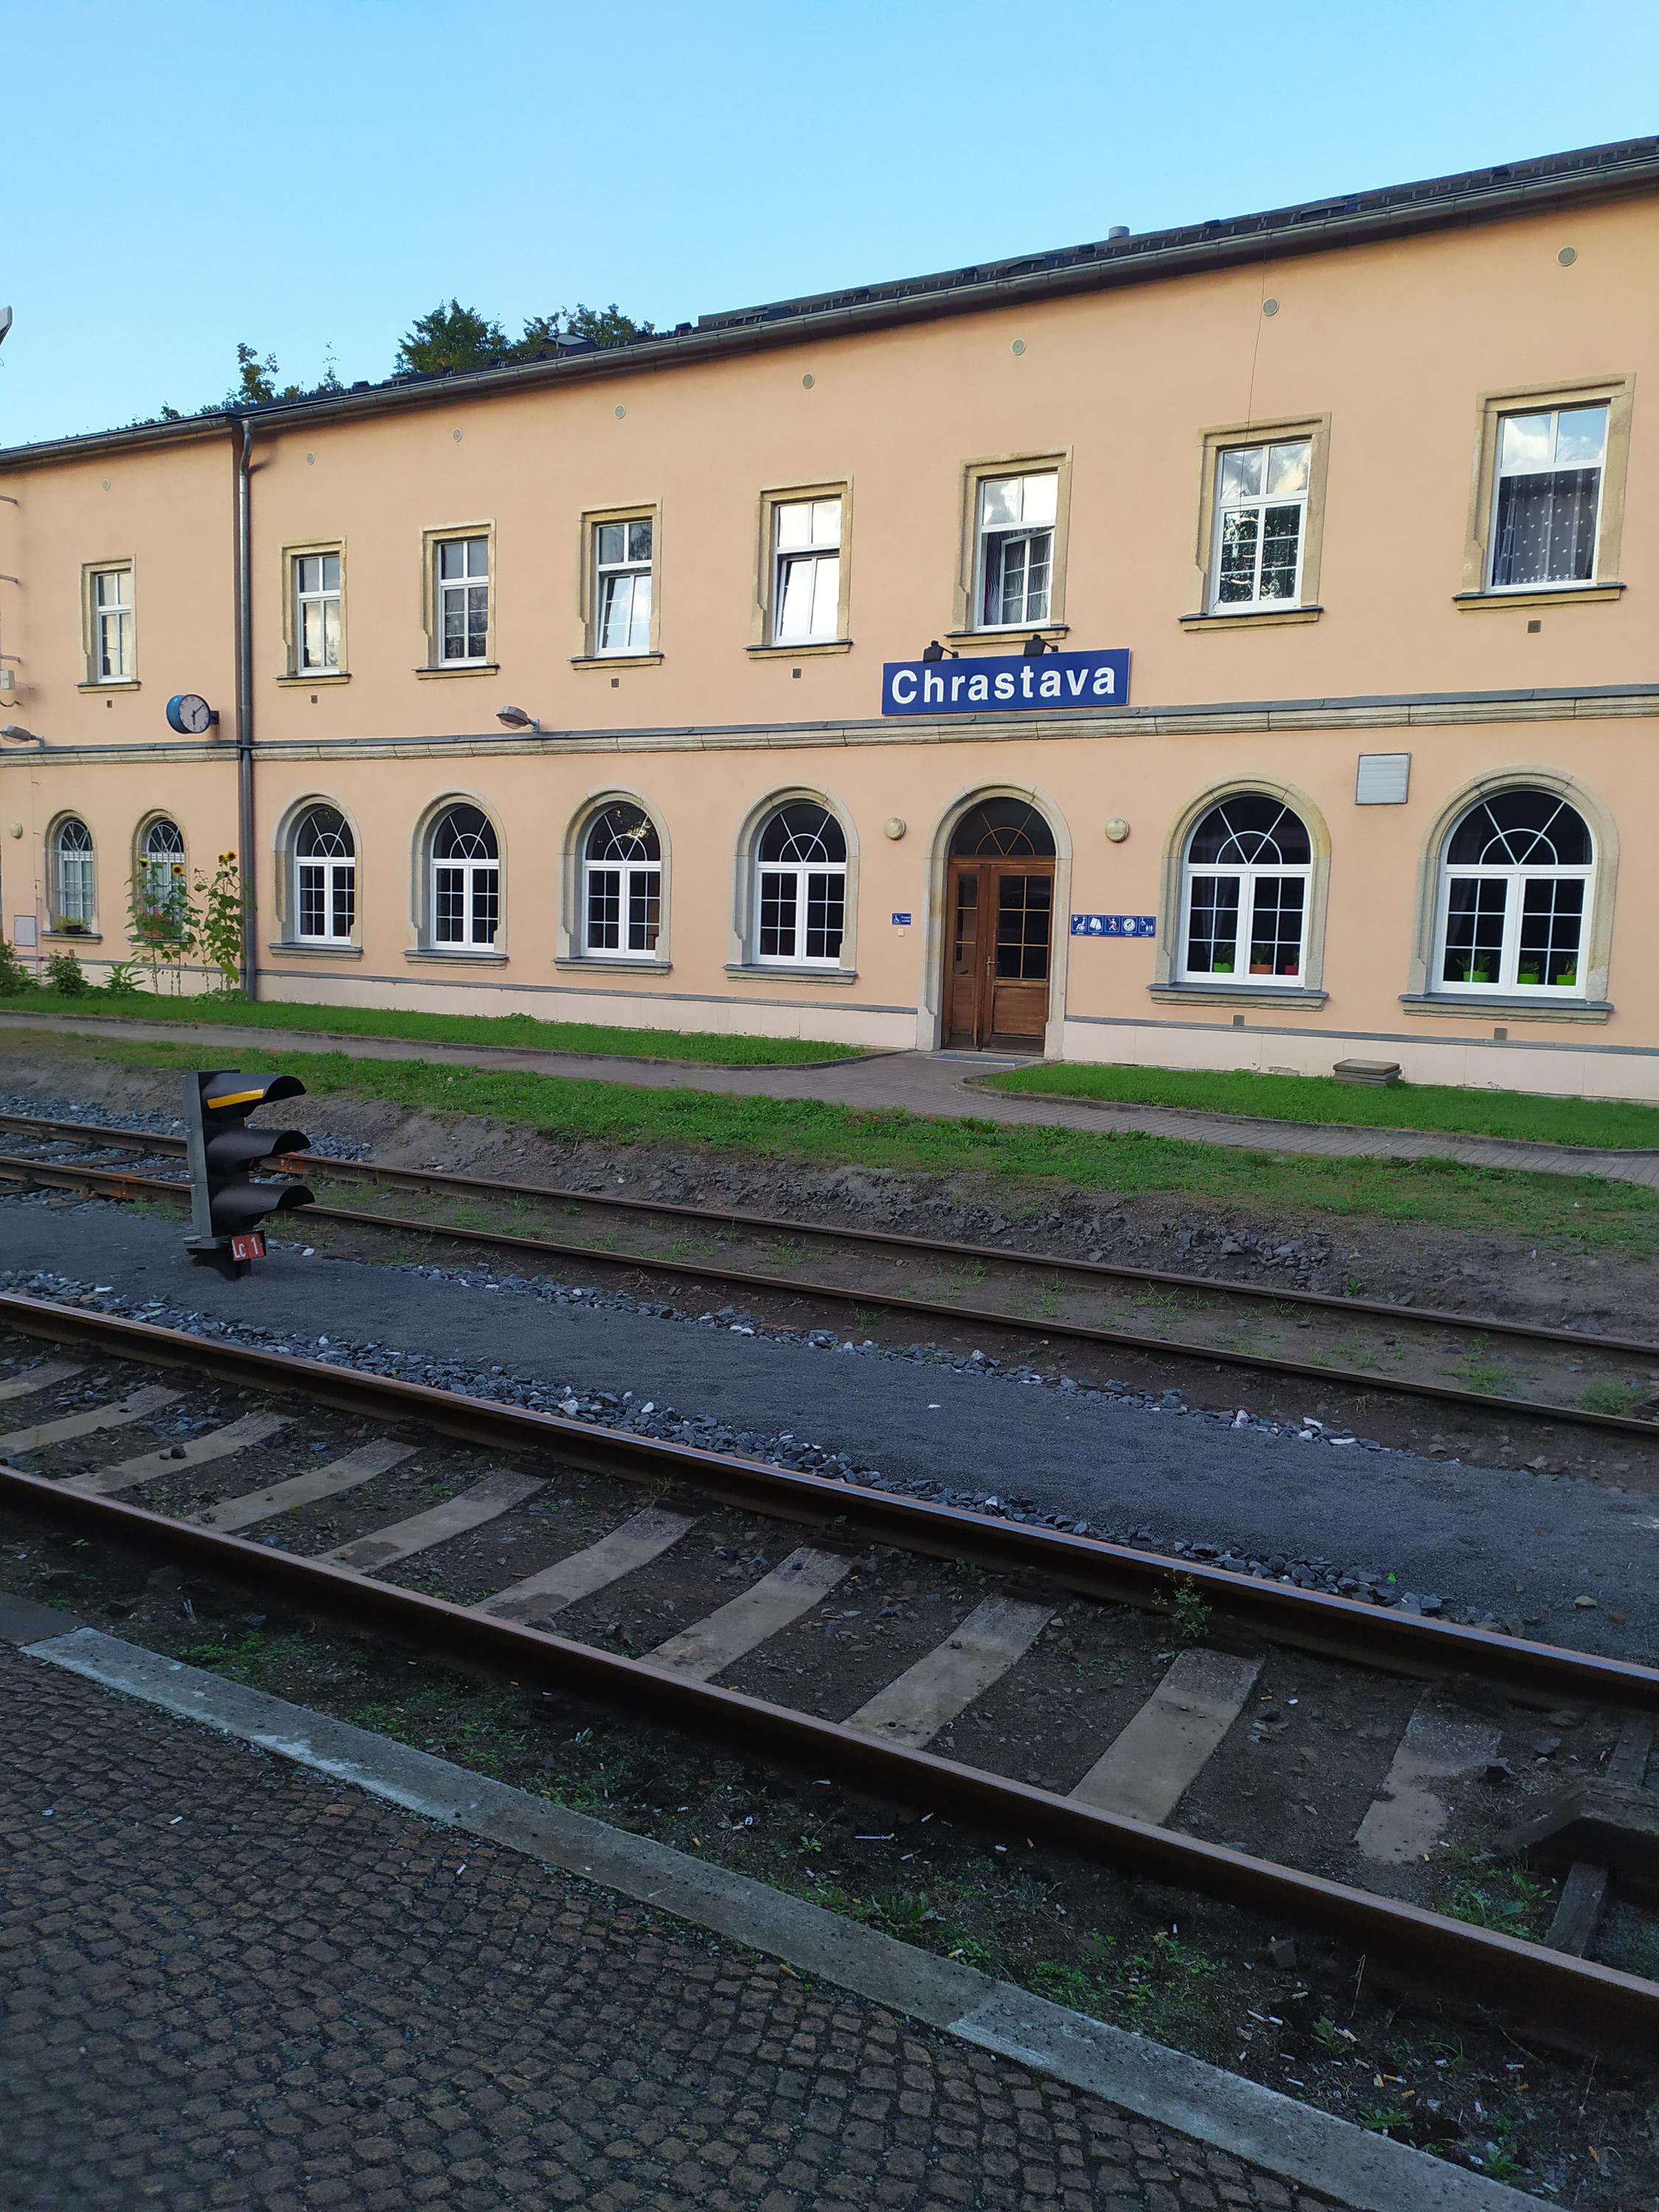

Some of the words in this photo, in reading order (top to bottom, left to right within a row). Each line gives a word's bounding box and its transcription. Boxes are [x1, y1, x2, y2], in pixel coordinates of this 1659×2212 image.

[891, 665, 1116, 704] Chrastava
[232, 1239, 246, 1258] Lc
[251, 1237, 258, 1254] 1
